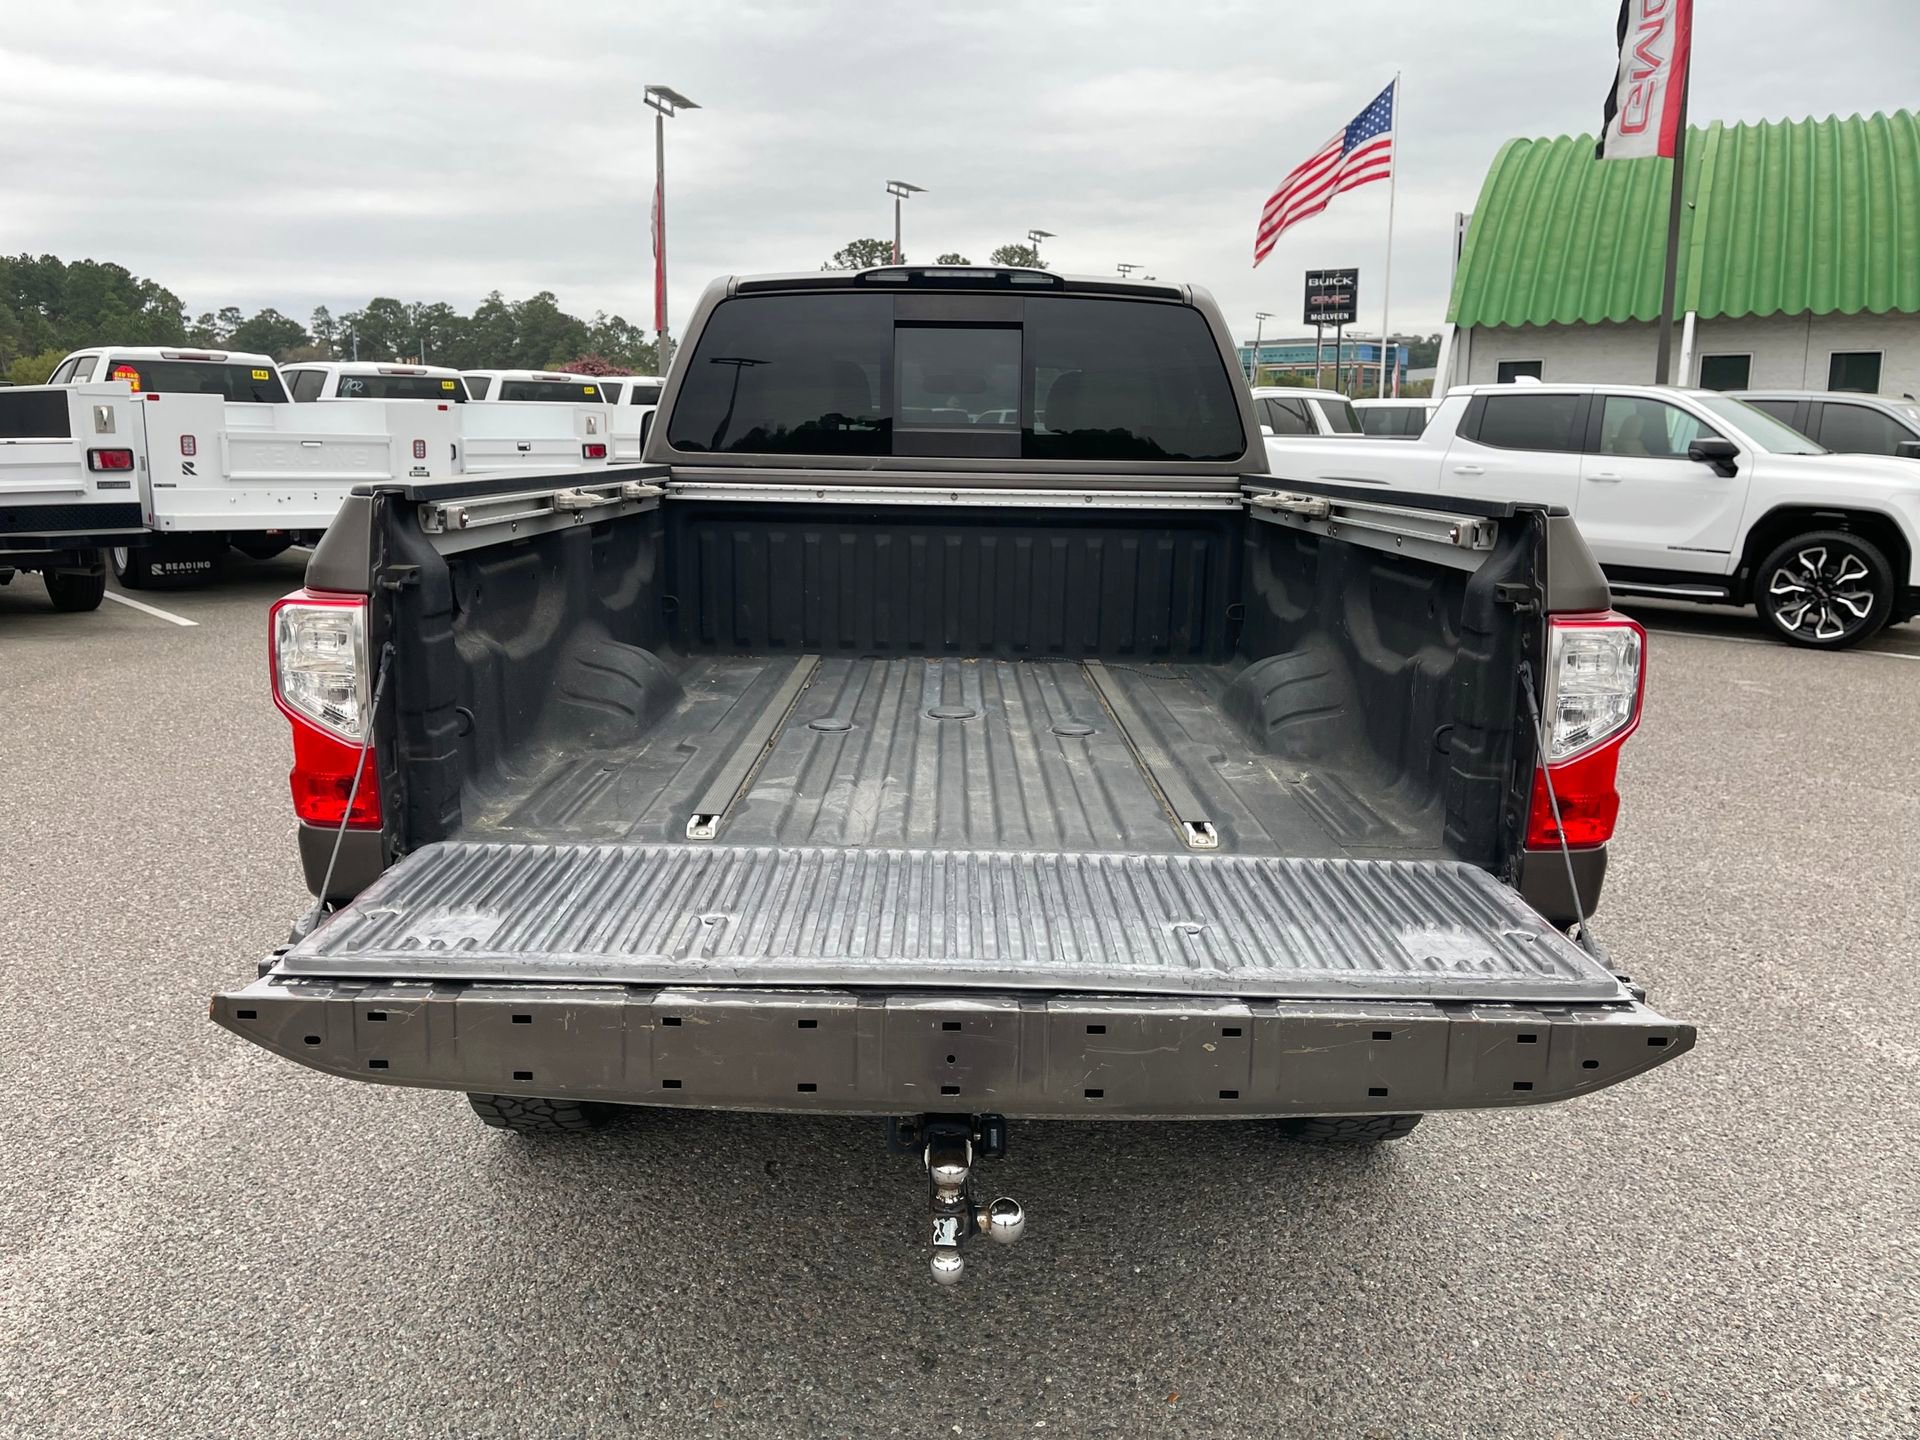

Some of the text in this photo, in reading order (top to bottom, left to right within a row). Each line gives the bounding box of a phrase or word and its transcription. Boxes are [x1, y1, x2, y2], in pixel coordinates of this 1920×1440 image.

[1308, 276, 1353, 286] BUICK
[1310, 294, 1350, 304] GMC
[340, 377, 364, 392] 1702
[165, 561, 211, 570] READING
